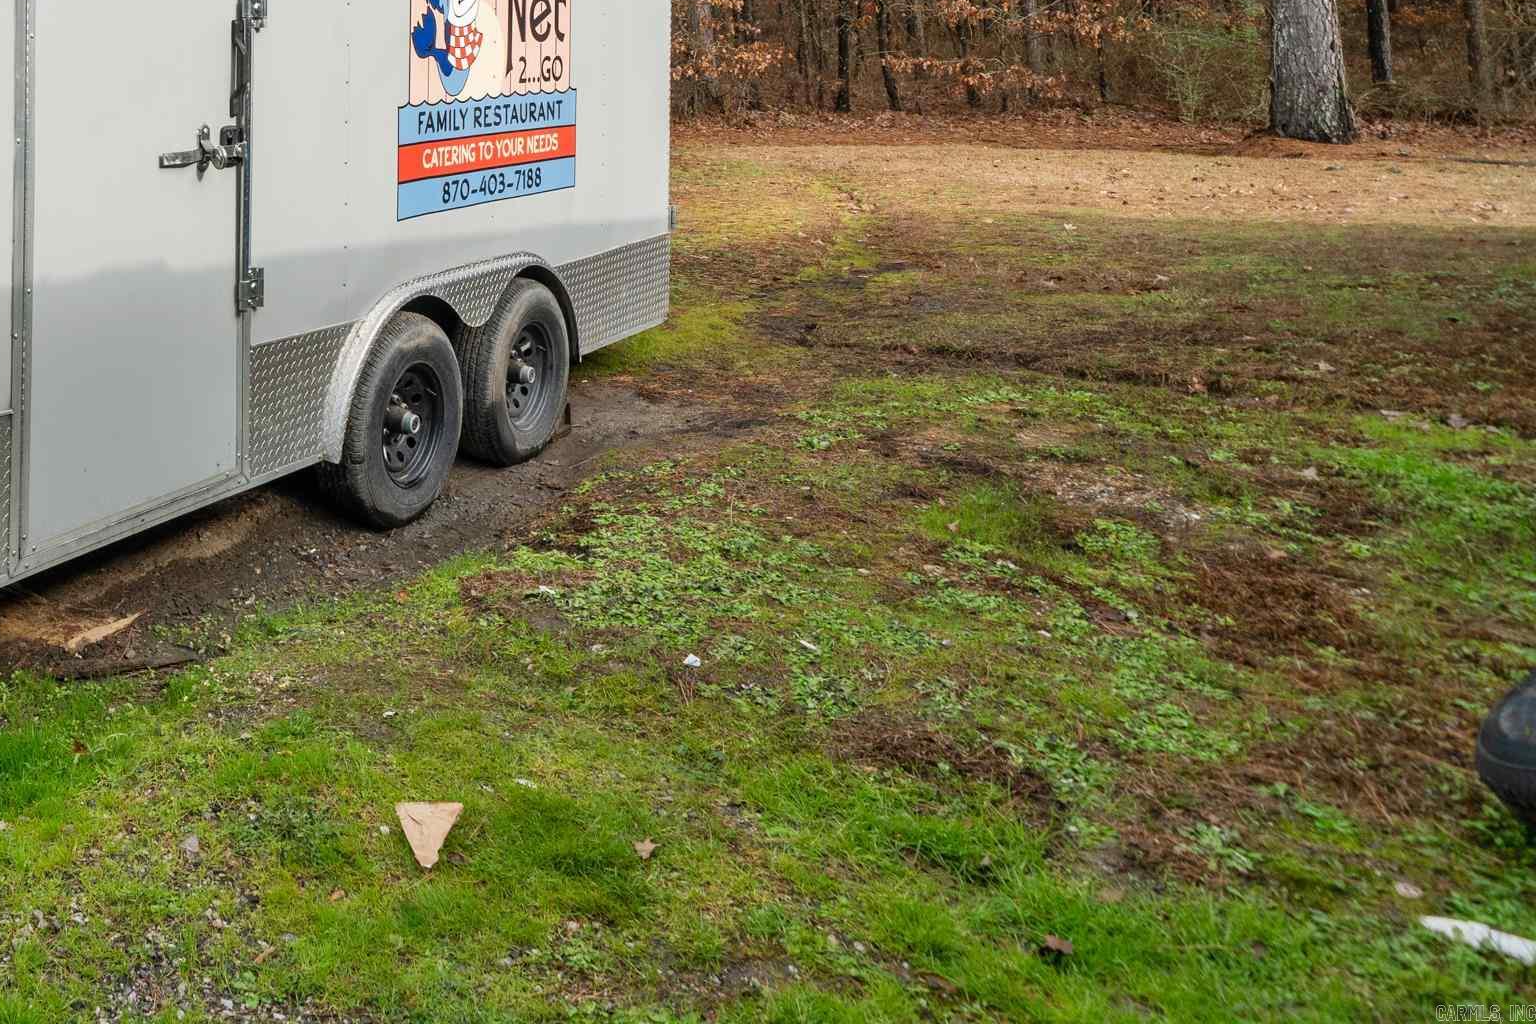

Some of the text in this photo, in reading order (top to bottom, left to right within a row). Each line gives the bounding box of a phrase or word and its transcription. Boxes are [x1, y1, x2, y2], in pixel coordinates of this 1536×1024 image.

[417, 100, 563, 135] FAMILY RESTAURANT
[422, 133, 559, 169] CATERING TO YOUR NEEDS
[442, 167, 542, 204] 870-403-7188
